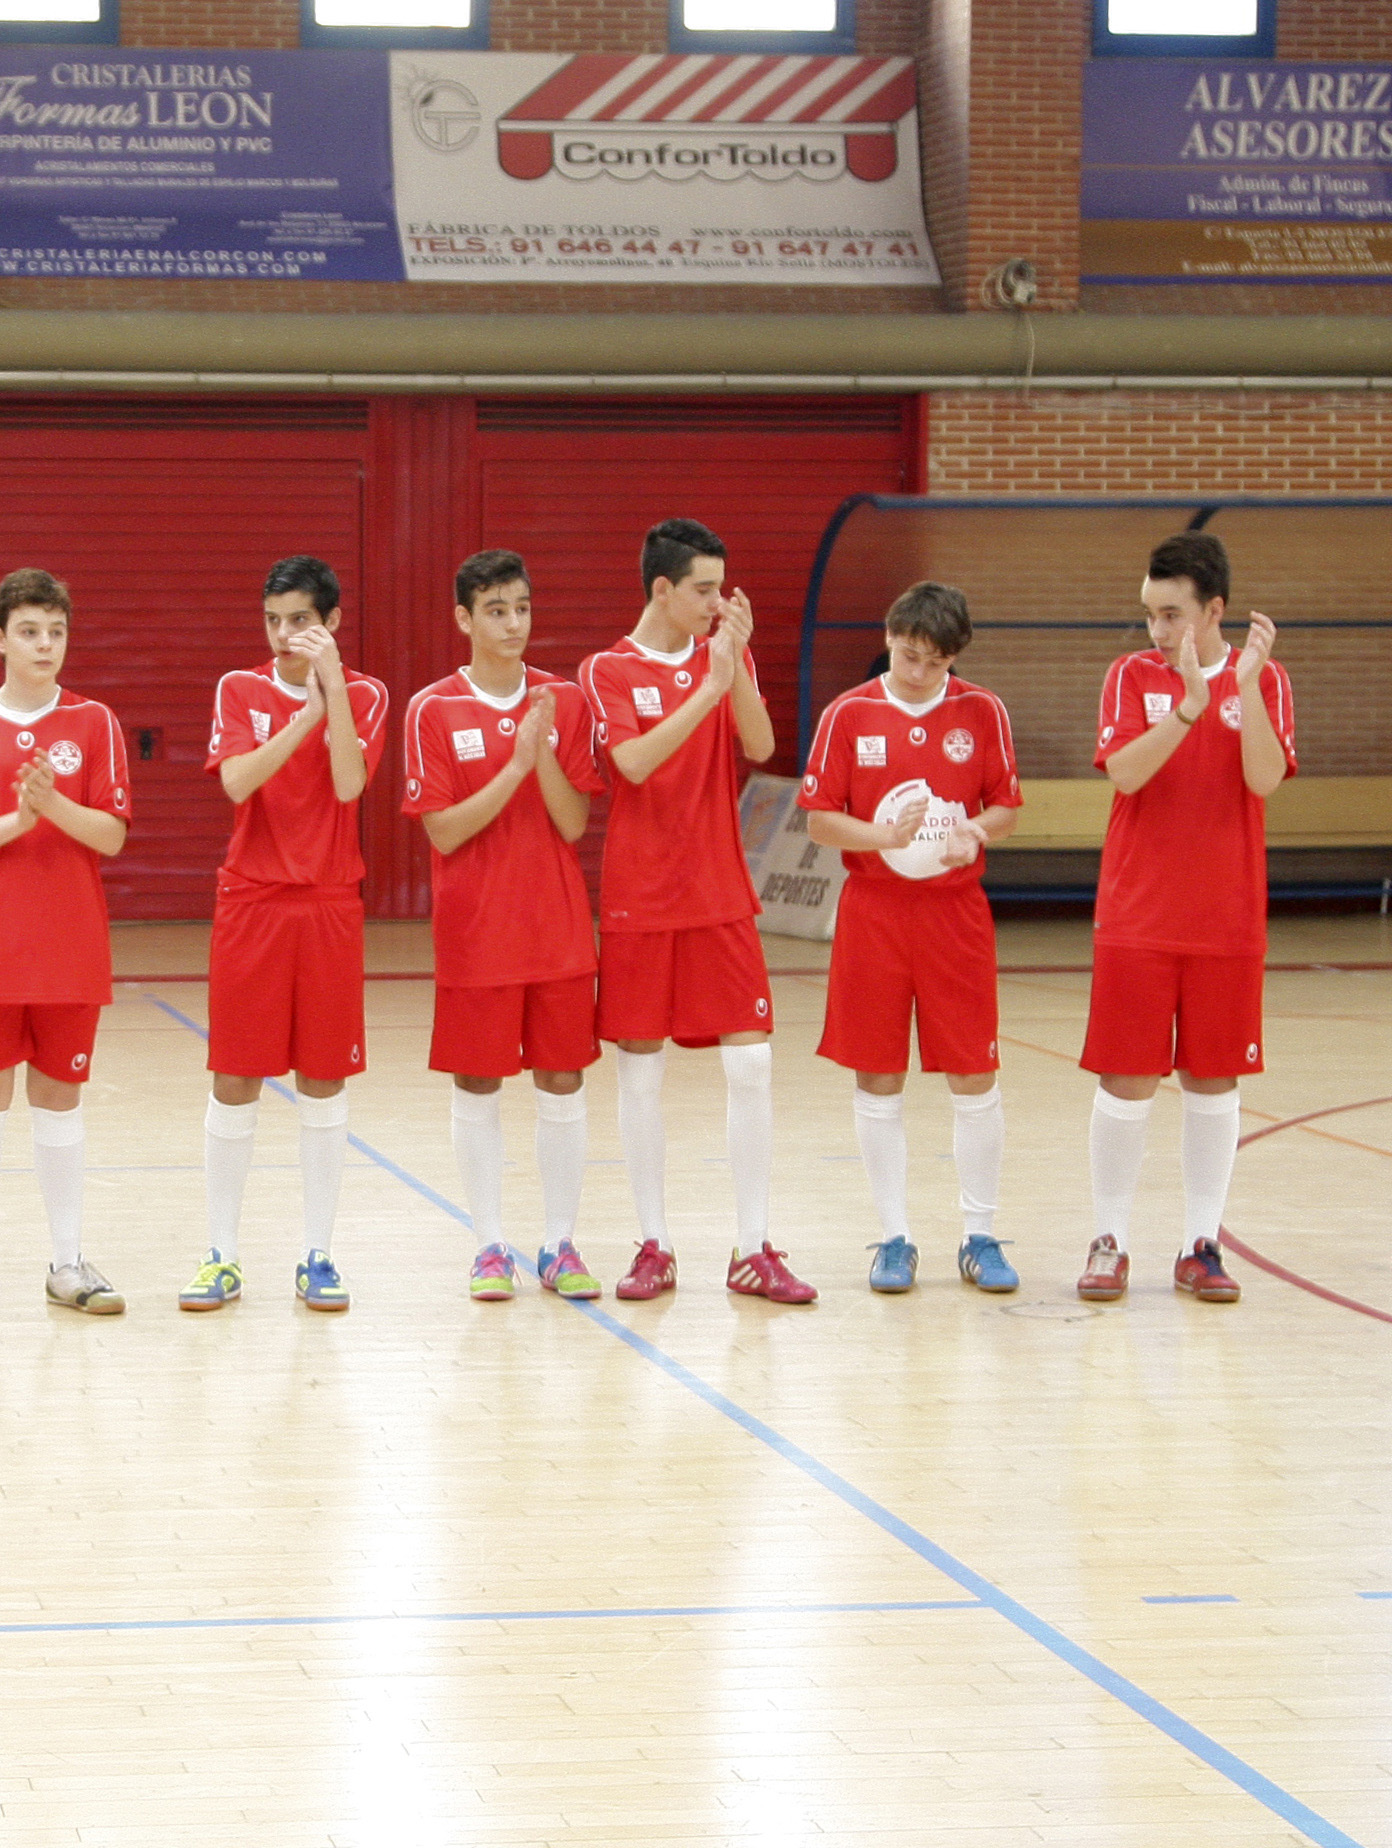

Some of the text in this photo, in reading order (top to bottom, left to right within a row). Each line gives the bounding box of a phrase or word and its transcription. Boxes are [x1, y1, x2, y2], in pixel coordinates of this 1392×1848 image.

[51, 62, 253, 88] CRISTALERIAS
[1183, 72, 1391, 113] ALVAREZ
[146, 91, 274, 130] LEON
[98, 136, 123, 151] DE
[127, 136, 216, 152] ALUMINIO
[219, 137, 233, 152] Y
[236, 137, 274, 153] PVC
[1180, 119, 1392, 160] ASESORES
[564, 142, 836, 168] ConforToldo
[1288, 174, 1309, 194] de
[1313, 174, 1371, 194] Fincas
[1186, 193, 1238, 214] Fiscal
[524, 225, 557, 236] DE
[562, 225, 661, 236] TOLDOS
[510, 238, 544, 254] 91
[557, 238, 613, 254] 646
[622, 239, 657, 255] 44
[668, 240, 701, 255] 47
[731, 240, 765, 255] 91
[778, 240, 830, 256] 647
[842, 241, 875, 256] 47
[888, 242, 920, 257] 41
[760, 872, 831, 907] DEPORTES
